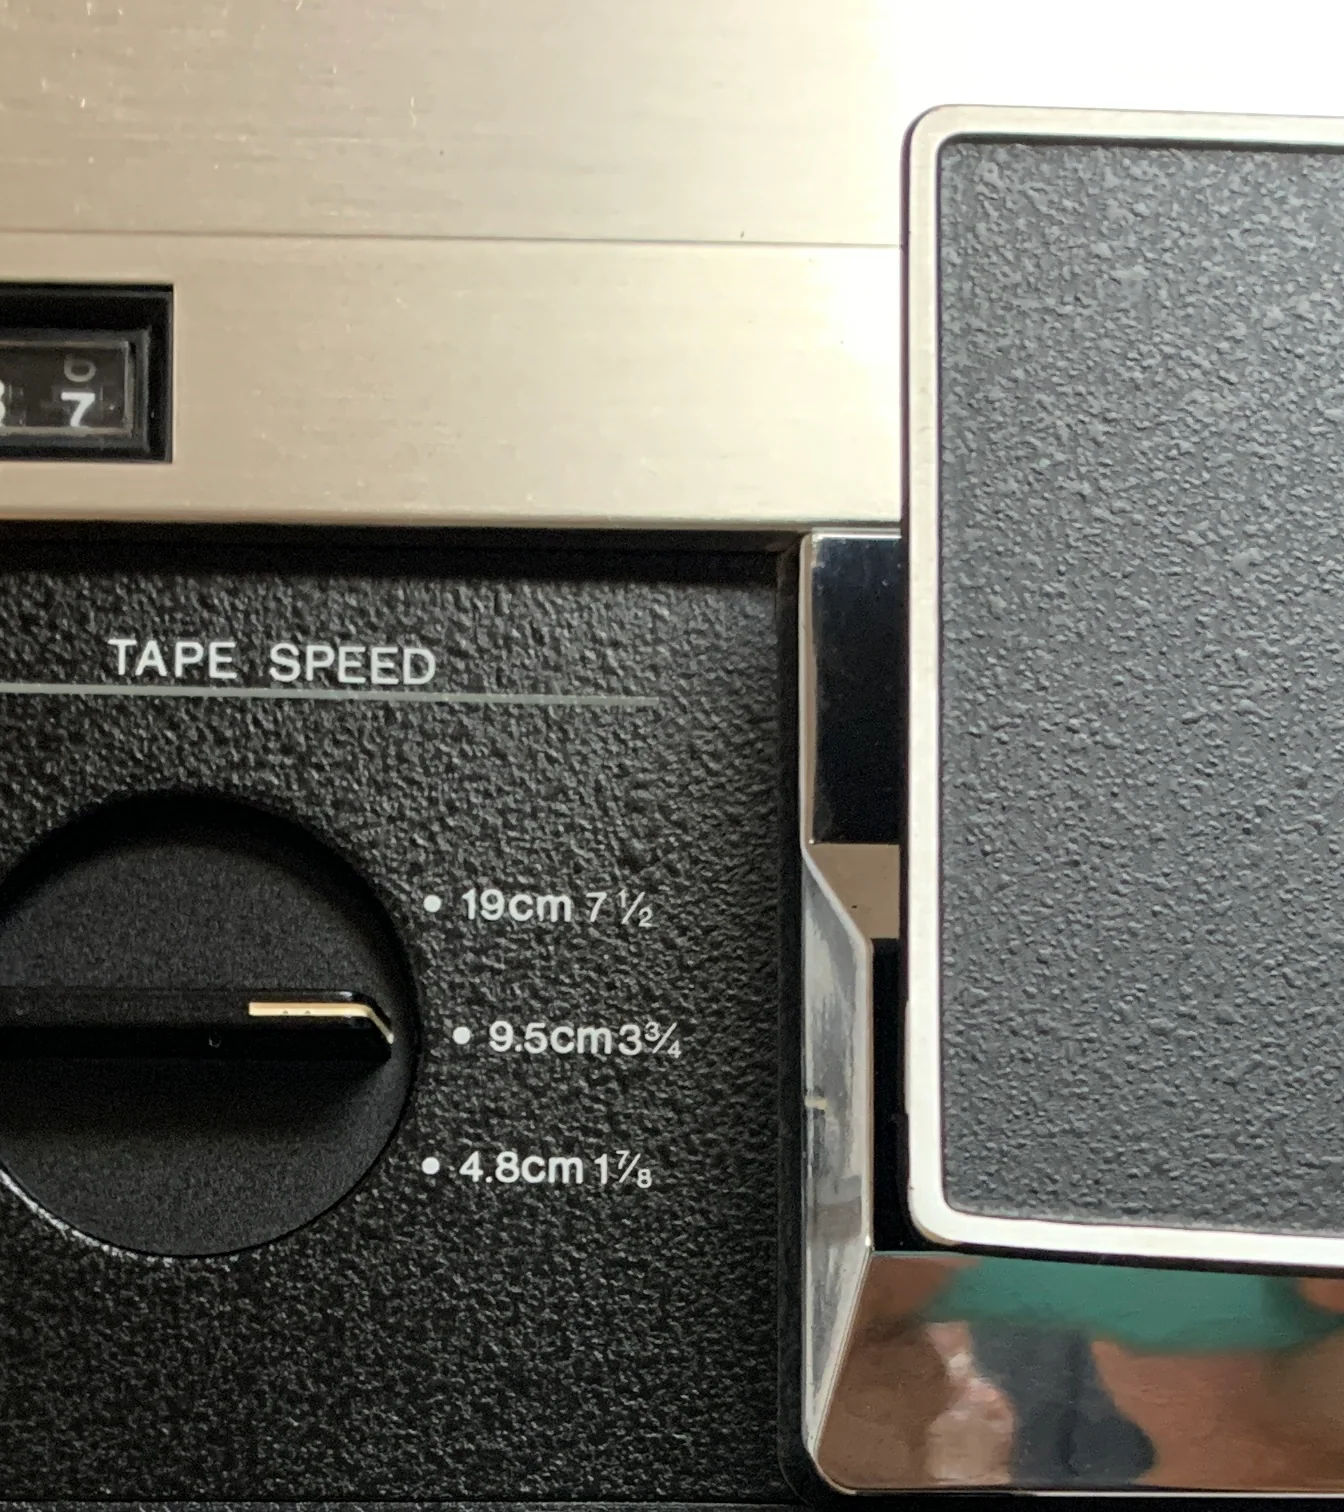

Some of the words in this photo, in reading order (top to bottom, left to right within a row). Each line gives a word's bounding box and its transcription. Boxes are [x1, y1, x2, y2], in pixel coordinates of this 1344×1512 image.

[107, 637, 238, 680] TAPE
[268, 641, 437, 685] SPEED
[461, 887, 573, 923] 19cm
[459, 1149, 584, 1184] 4.8cm
